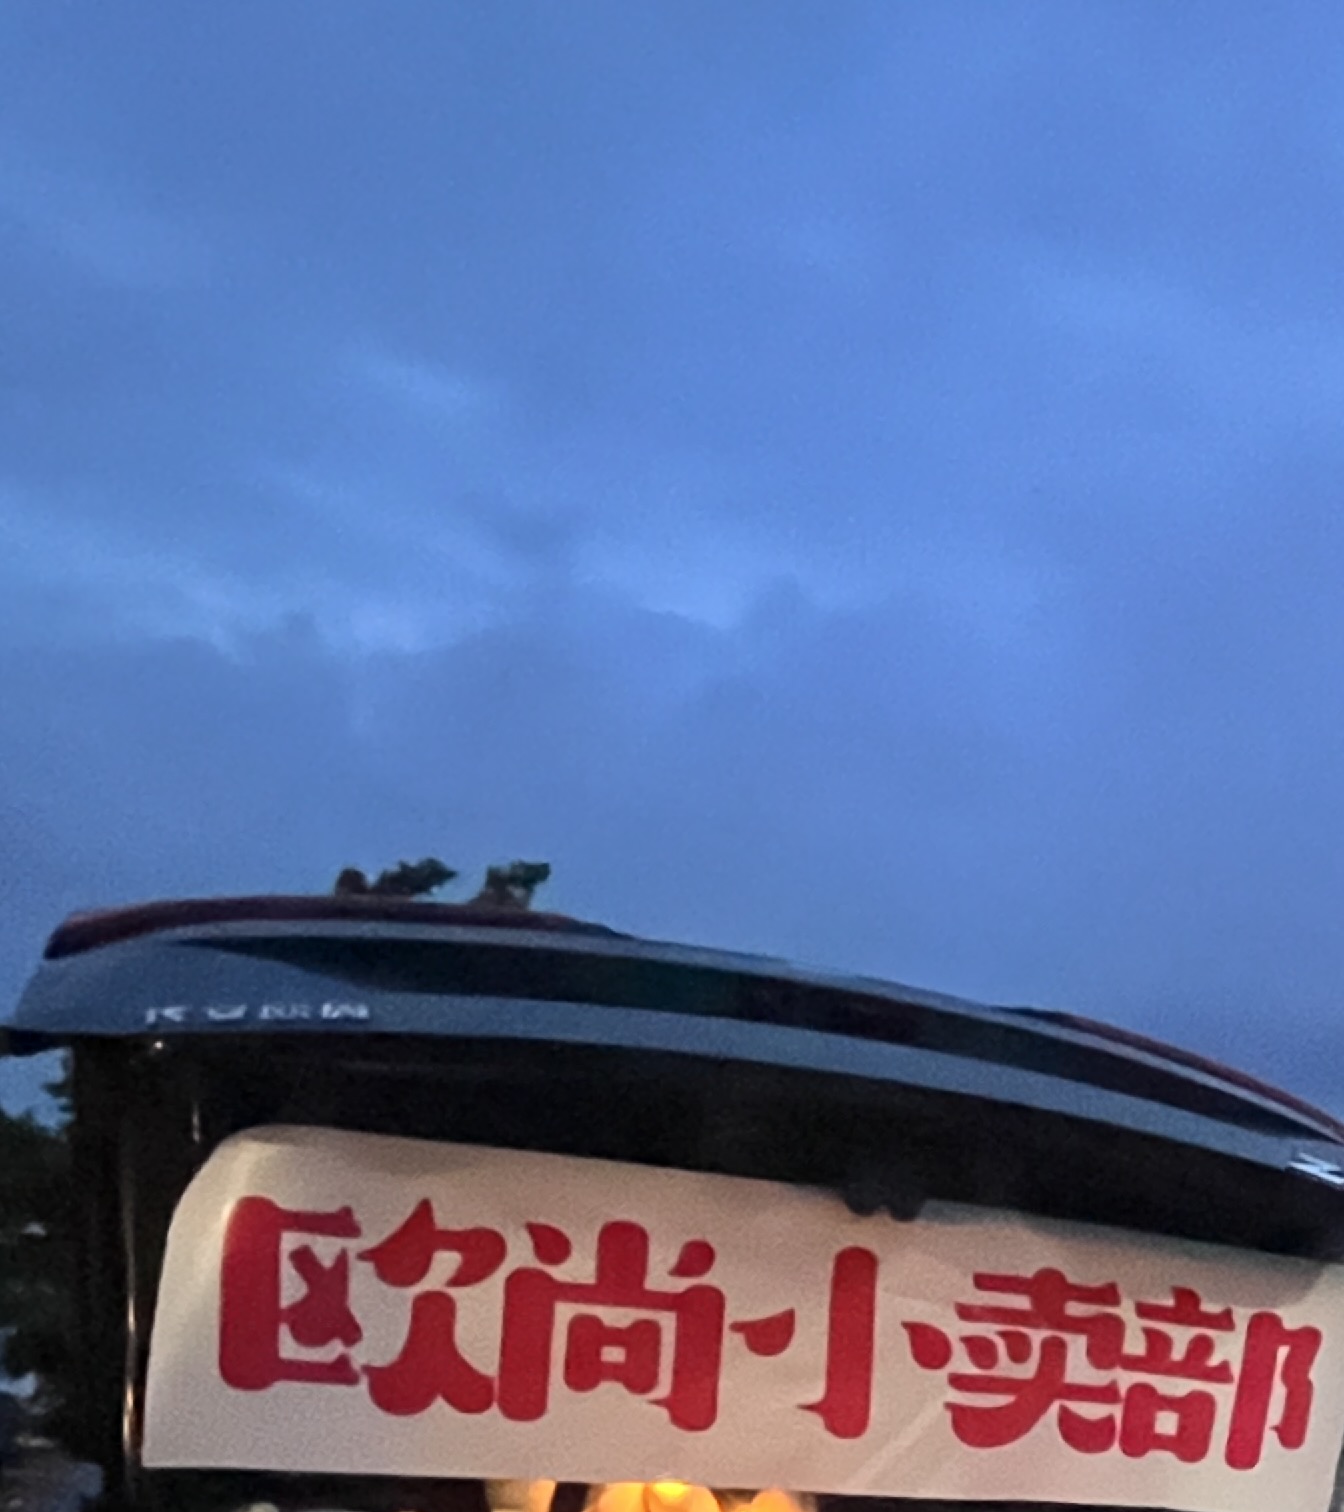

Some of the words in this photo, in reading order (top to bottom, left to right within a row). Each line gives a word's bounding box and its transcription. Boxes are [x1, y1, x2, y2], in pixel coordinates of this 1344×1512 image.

[219, 1195, 1323, 1470] 欧尚小卖部
